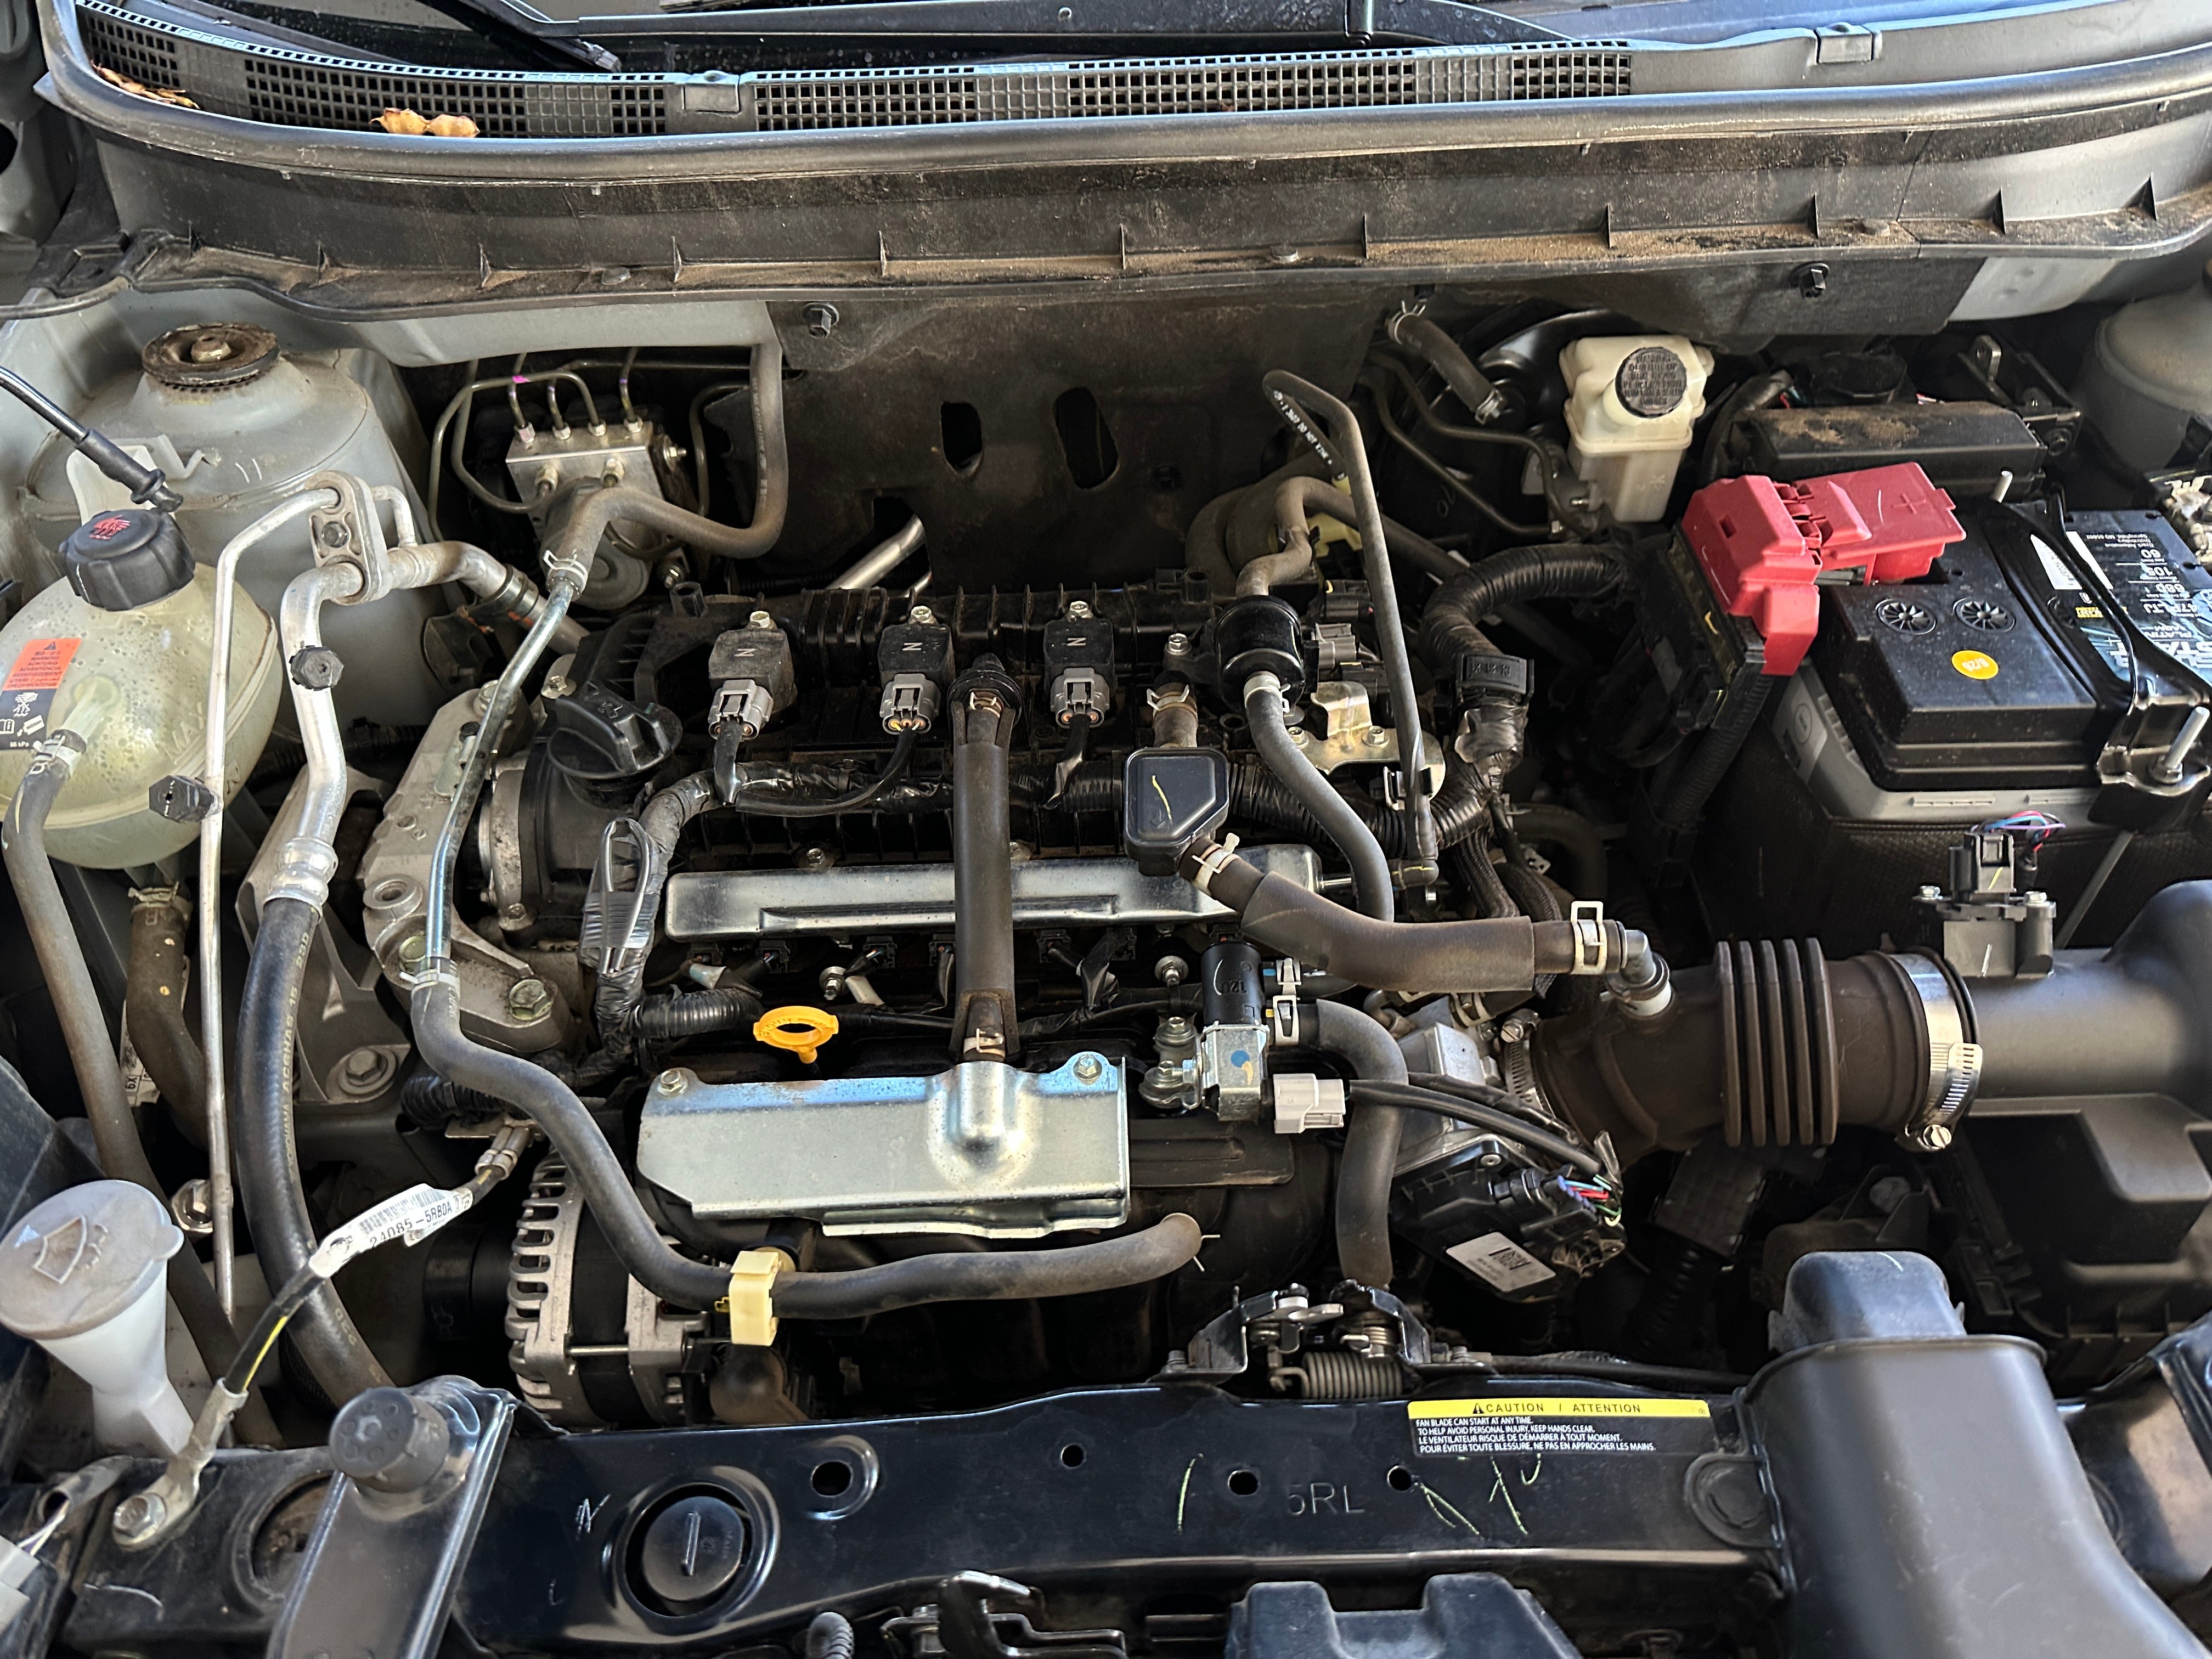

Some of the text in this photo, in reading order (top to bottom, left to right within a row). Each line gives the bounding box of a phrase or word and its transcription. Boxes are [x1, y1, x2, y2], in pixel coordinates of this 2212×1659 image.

[2141, 549, 2161, 558] 60
[2146, 567, 2173, 576] 105
[1486, 1403, 1641, 1413] CAUTION ATTENTION
[1469, 1417, 1489, 1425] START
[1469, 1426, 1505, 1434] PERSONAL
[1505, 1425, 1530, 1434] INJURY,
[1573, 1425, 1595, 1433] CLEAR.
[1419, 1436, 1427, 1444] LE
[1428, 1435, 1477, 1444] VENTILATEUR
[1479, 1434, 1505, 1442] RISQUE
[1519, 1431, 1559, 1441] DÉMARRER
[1560, 1432, 1567, 1441] À
[1588, 1434, 1623, 1442] MOMENT.
[1420, 1444, 1442, 1453] POUR
[1443, 1443, 1468, 1452] ÉVITER
[1469, 1443, 1493, 1452] TOUTE
[1494, 1442, 1533, 1451] BLESSURE,
[1533, 1442, 1544, 1450] NE
[1571, 1442, 1616, 1450] APPROCHER
[1616, 1442, 1629, 1451] LES
[1630, 1442, 1656, 1451] MAINS.
